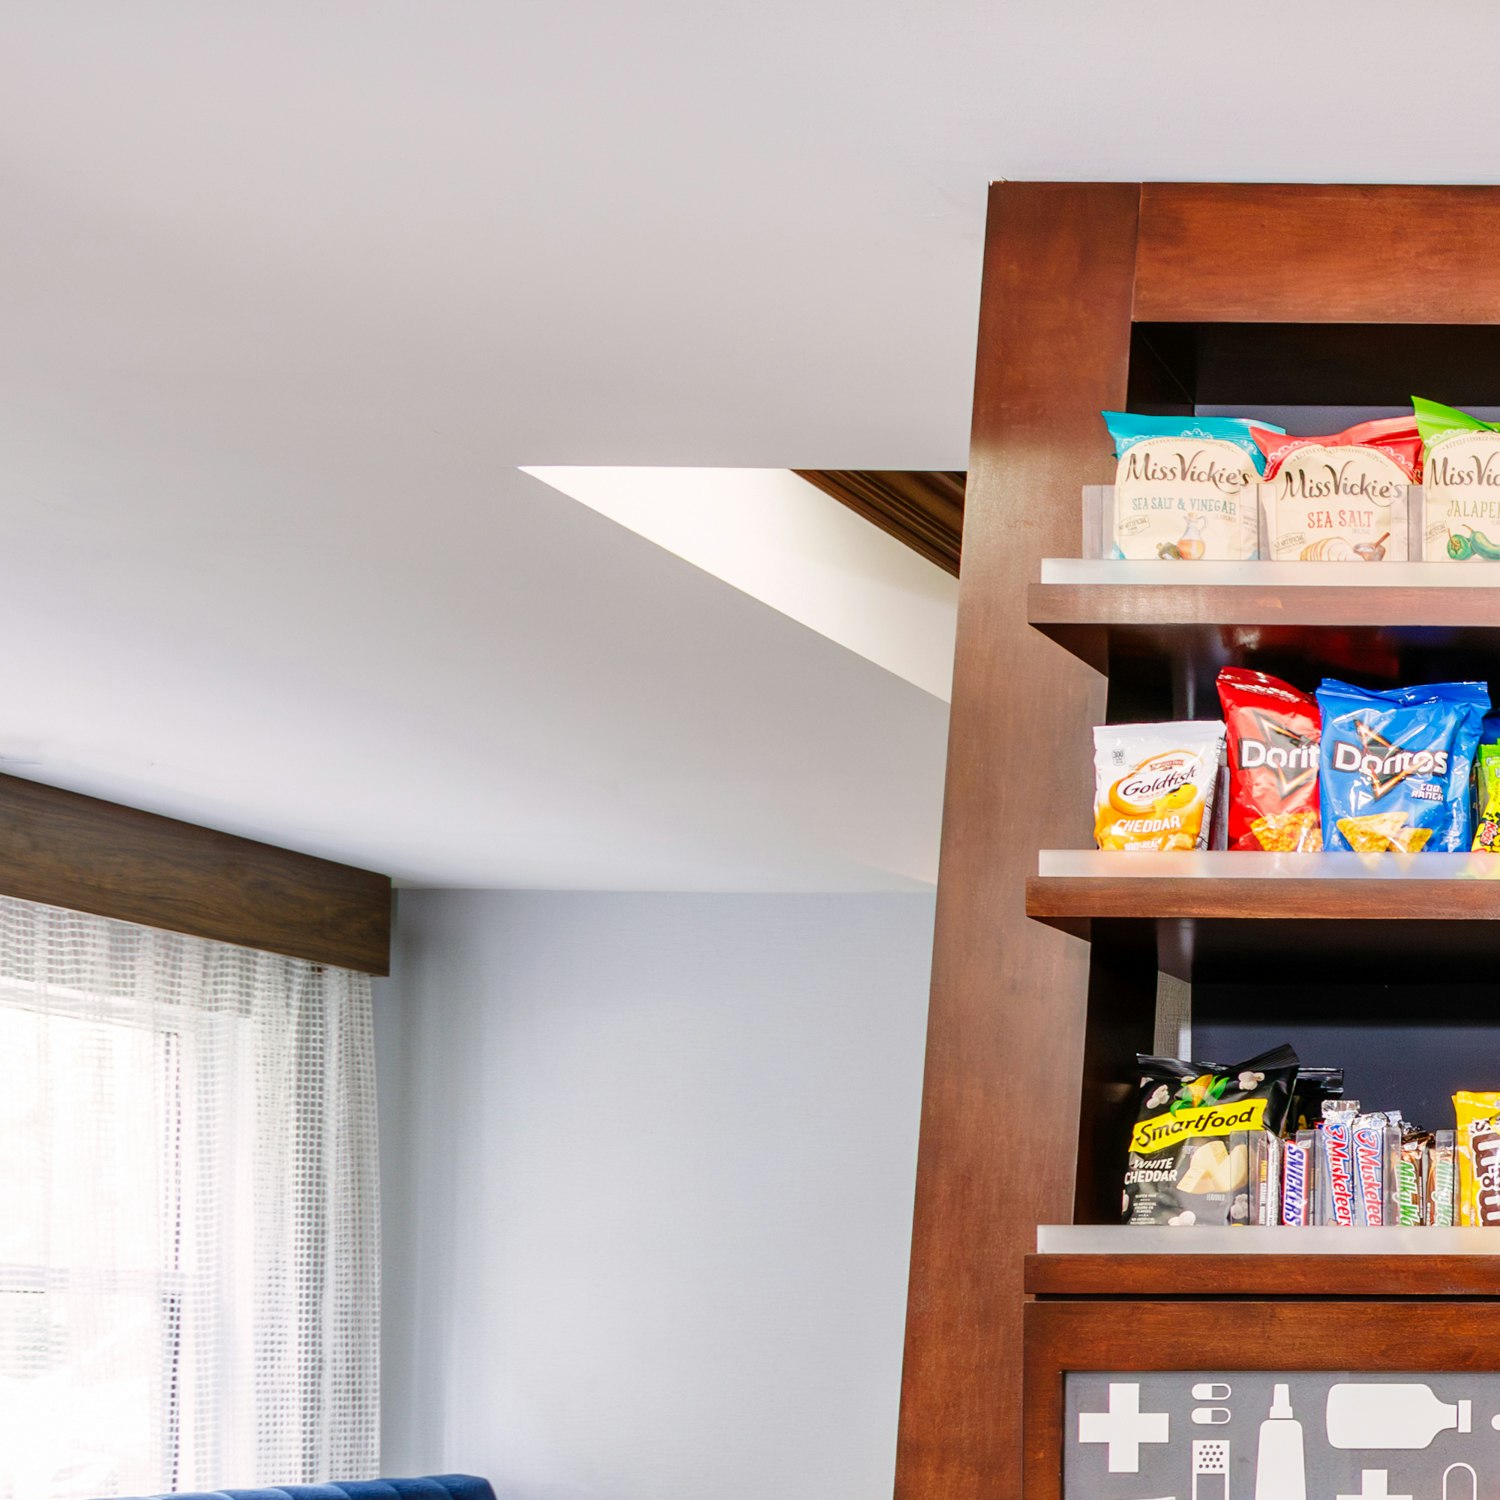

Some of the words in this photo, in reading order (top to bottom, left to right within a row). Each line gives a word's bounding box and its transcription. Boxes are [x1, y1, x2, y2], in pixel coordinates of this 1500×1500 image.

[1132, 498, 1149, 510] SEA
[1151, 497, 1173, 510] SALT
[1177, 500, 1186, 511] &
[1190, 499, 1236, 514] VINEGAR
[1307, 512, 1333, 529] SEA
[1340, 510, 1373, 528] SALT
[1335, 742, 1448, 775] Doritos
[1123, 768, 1198, 797] Goldfish
[1114, 815, 1181, 833] CHEDDAR
[1135, 1106, 1255, 1148] Smartfood
[1130, 1157, 1174, 1171] WHITE
[1124, 1170, 1177, 1185] CHEDDAR
[1284, 1144, 1306, 1226] SNICKERS
